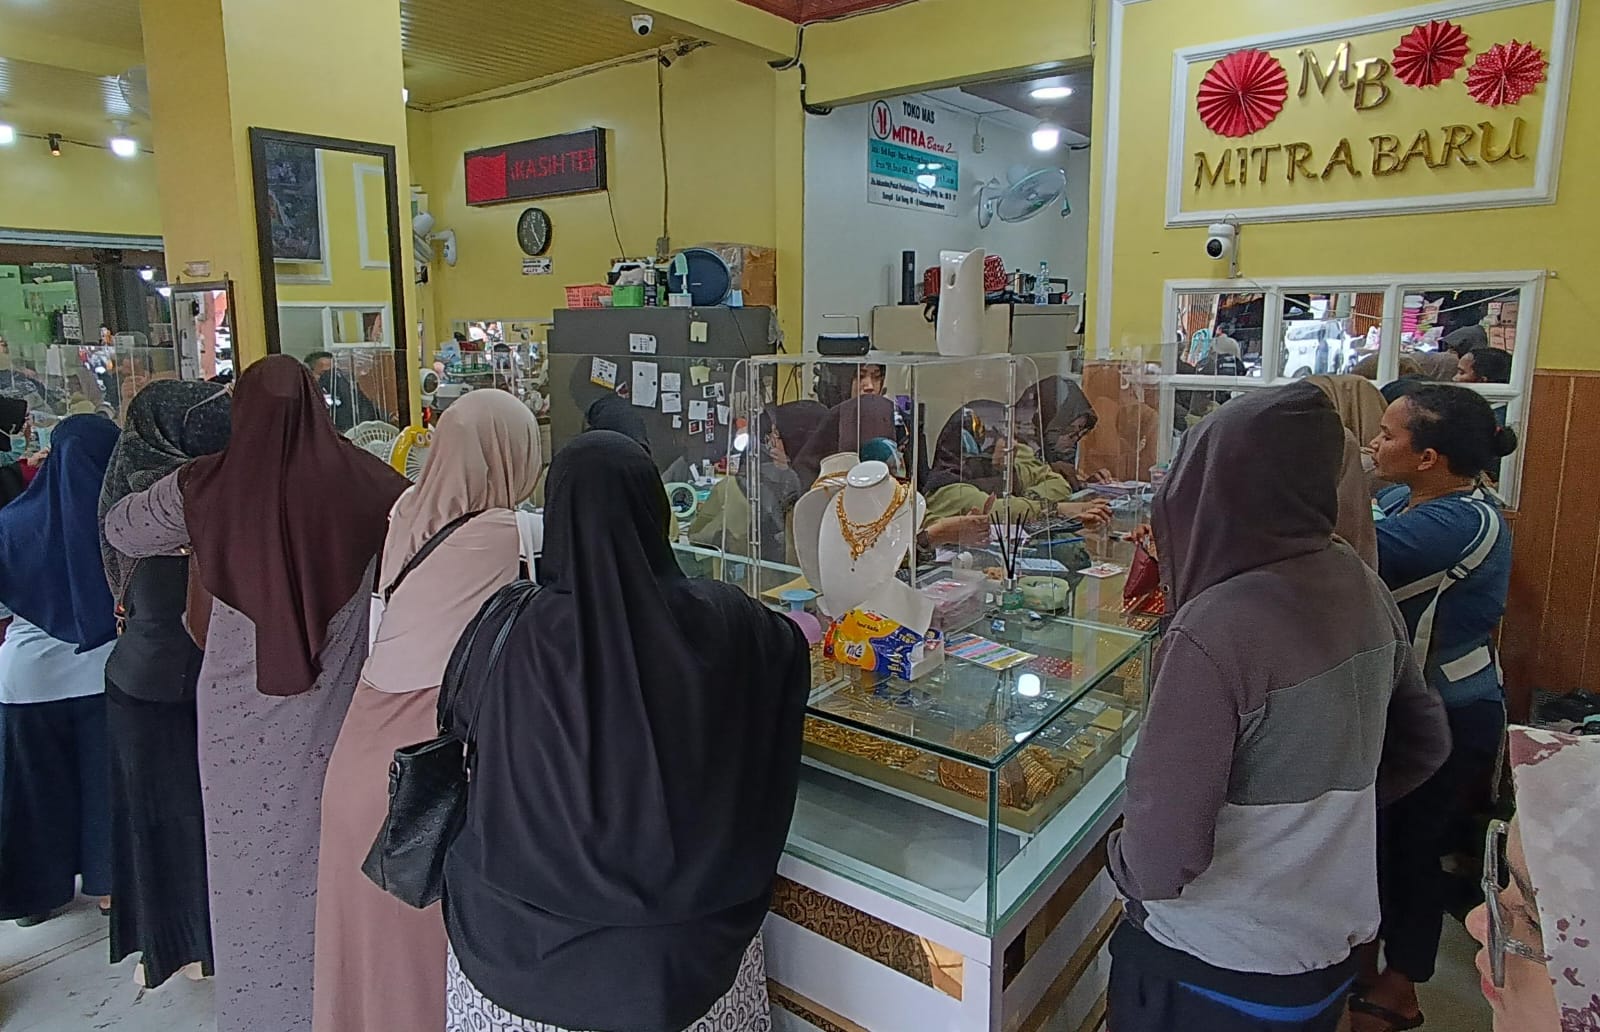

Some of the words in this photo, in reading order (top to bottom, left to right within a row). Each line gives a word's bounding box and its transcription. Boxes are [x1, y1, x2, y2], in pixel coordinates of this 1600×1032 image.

[1297, 41, 1392, 111] MB
[903, 101, 920, 120] TOKO
[922, 107, 935, 124] MAS
[892, 126, 925, 148] MITRA
[1194, 138, 1361, 190] MITRA
[1369, 117, 1527, 177] BARU
